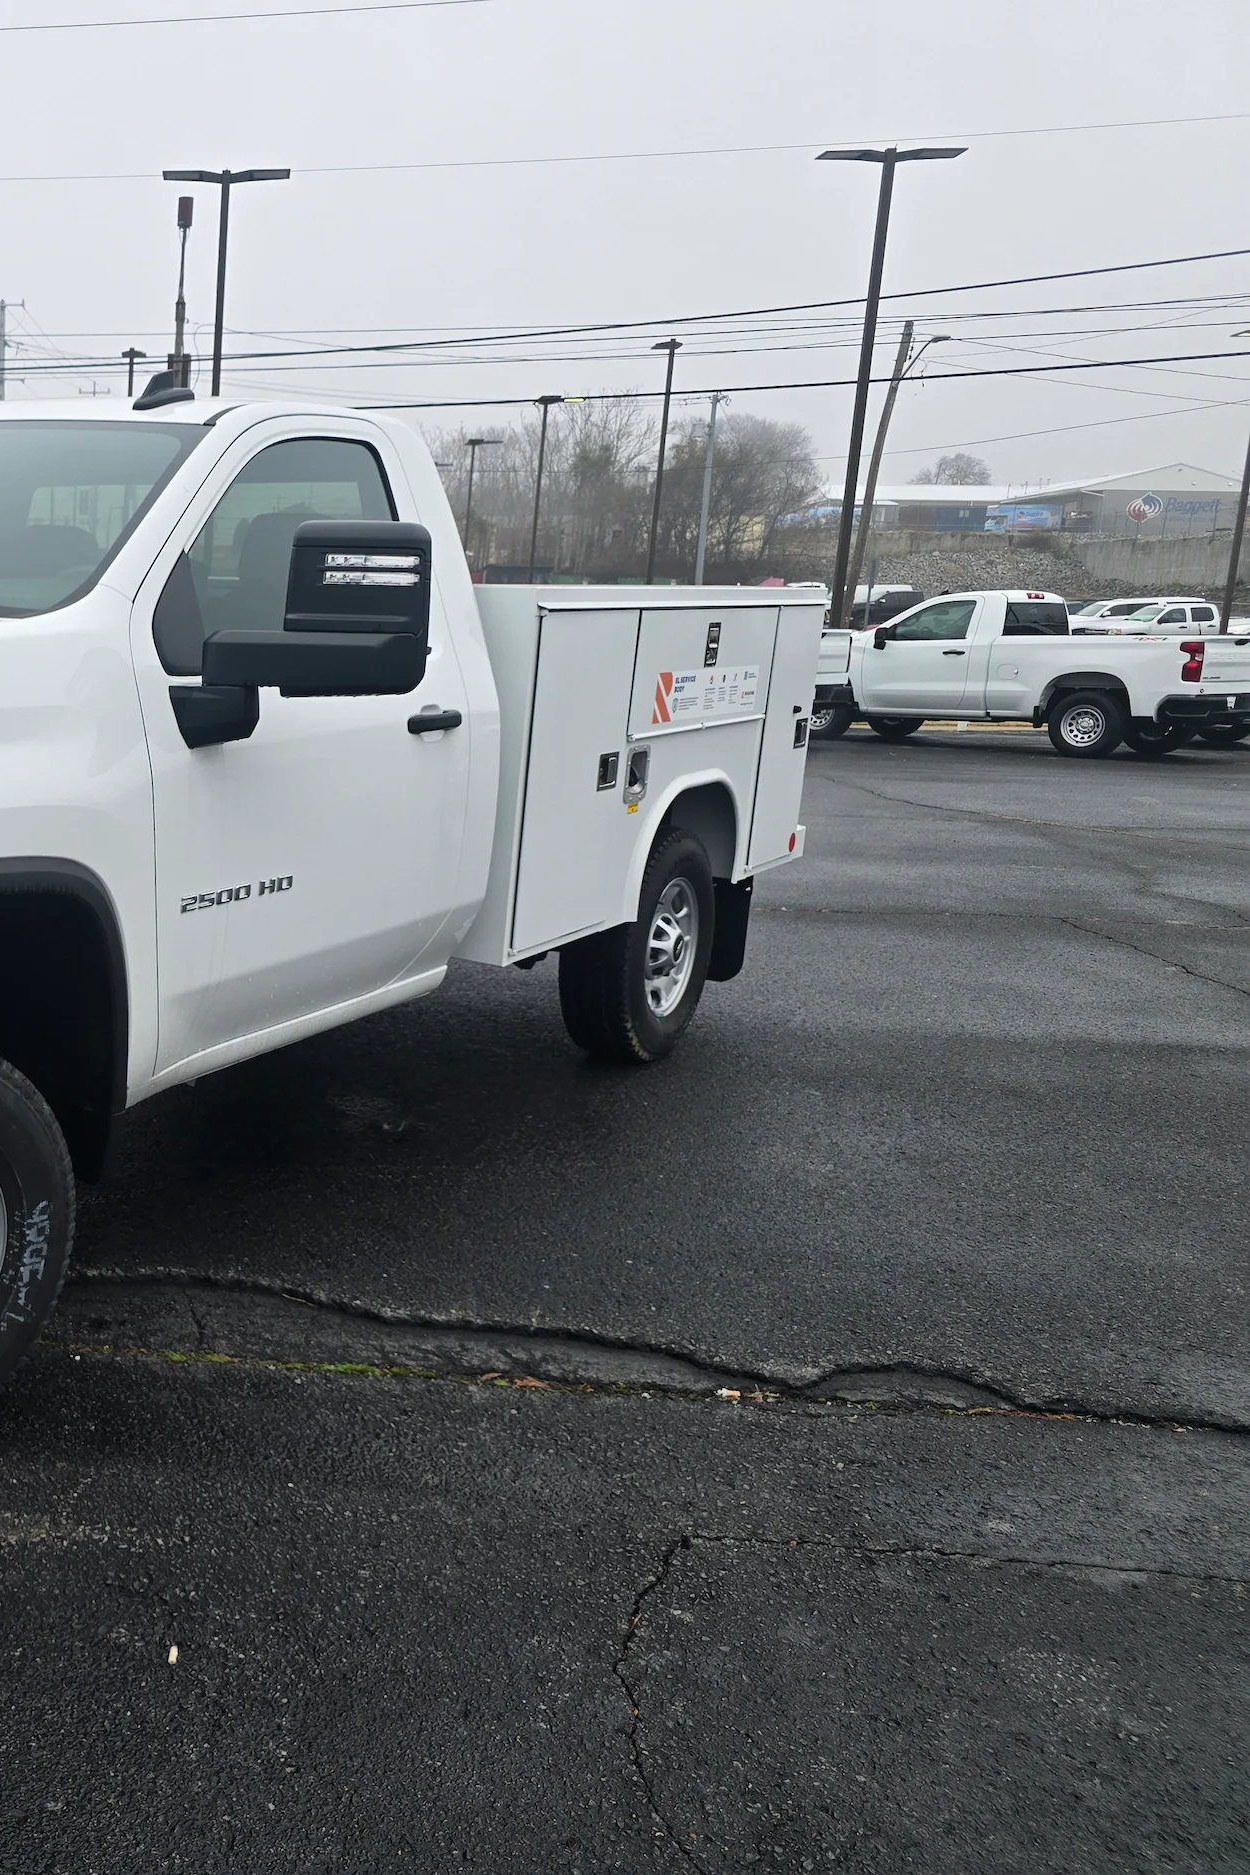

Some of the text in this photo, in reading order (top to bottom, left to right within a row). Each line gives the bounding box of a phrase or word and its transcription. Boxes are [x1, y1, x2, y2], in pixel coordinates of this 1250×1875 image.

[1165, 497, 1222, 515] Baggett
[180, 874, 293, 914] 2500 HD
